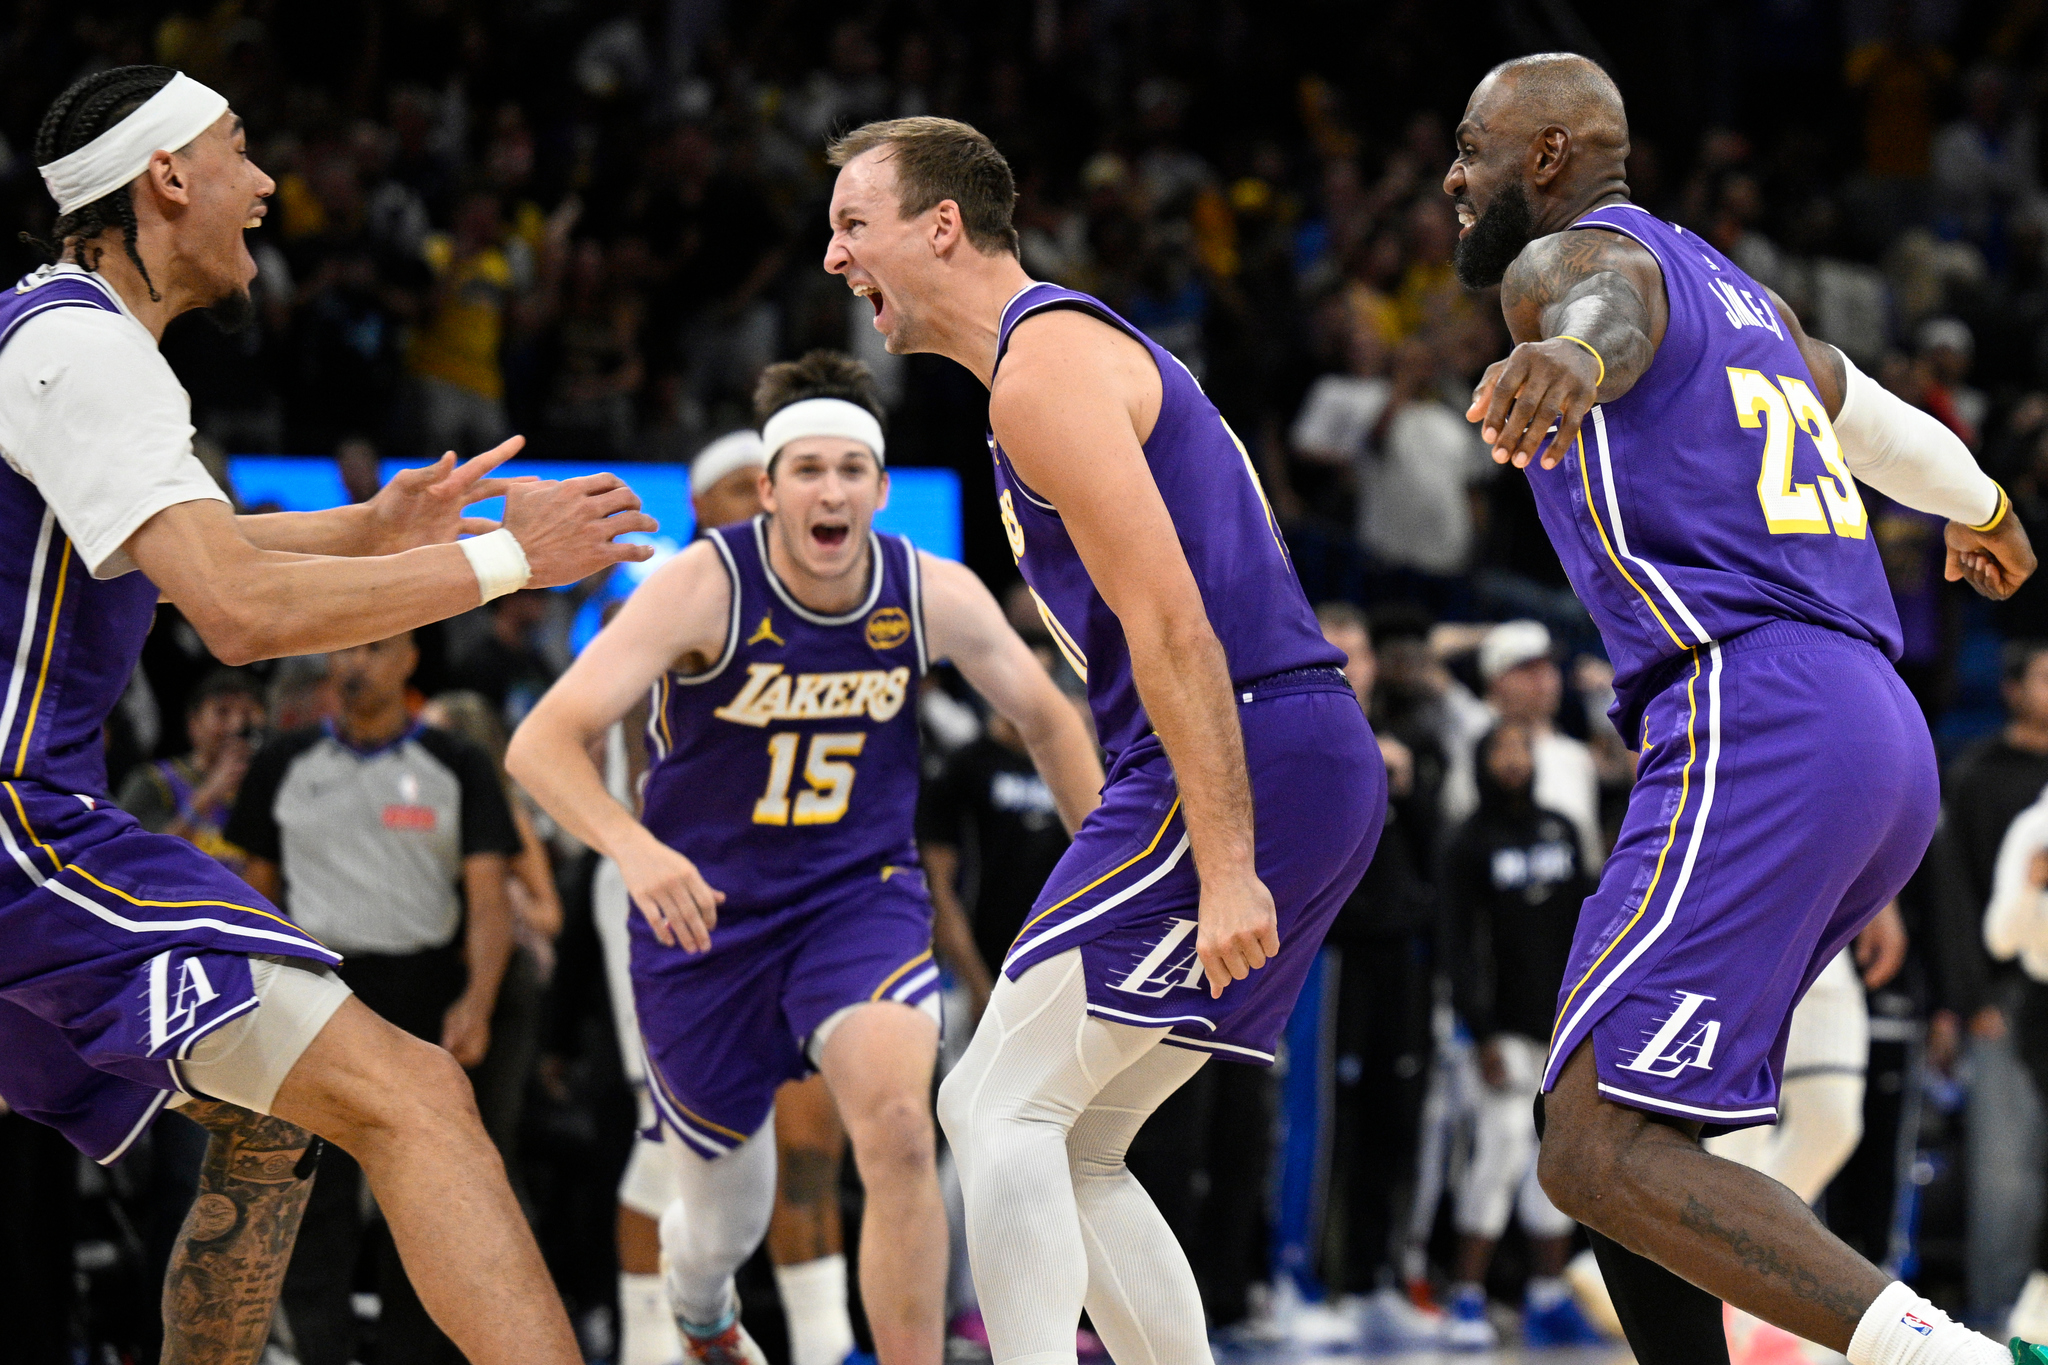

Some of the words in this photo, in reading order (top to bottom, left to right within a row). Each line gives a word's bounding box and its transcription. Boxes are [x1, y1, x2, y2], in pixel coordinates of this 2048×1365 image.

[1725, 366, 1868, 540] 23
[714, 663, 910, 728] LAKERS
[752, 732, 866, 826] 15
[1105, 916, 1202, 998] LA
[143, 949, 220, 1058] LA
[1615, 989, 1721, 1078] LA
